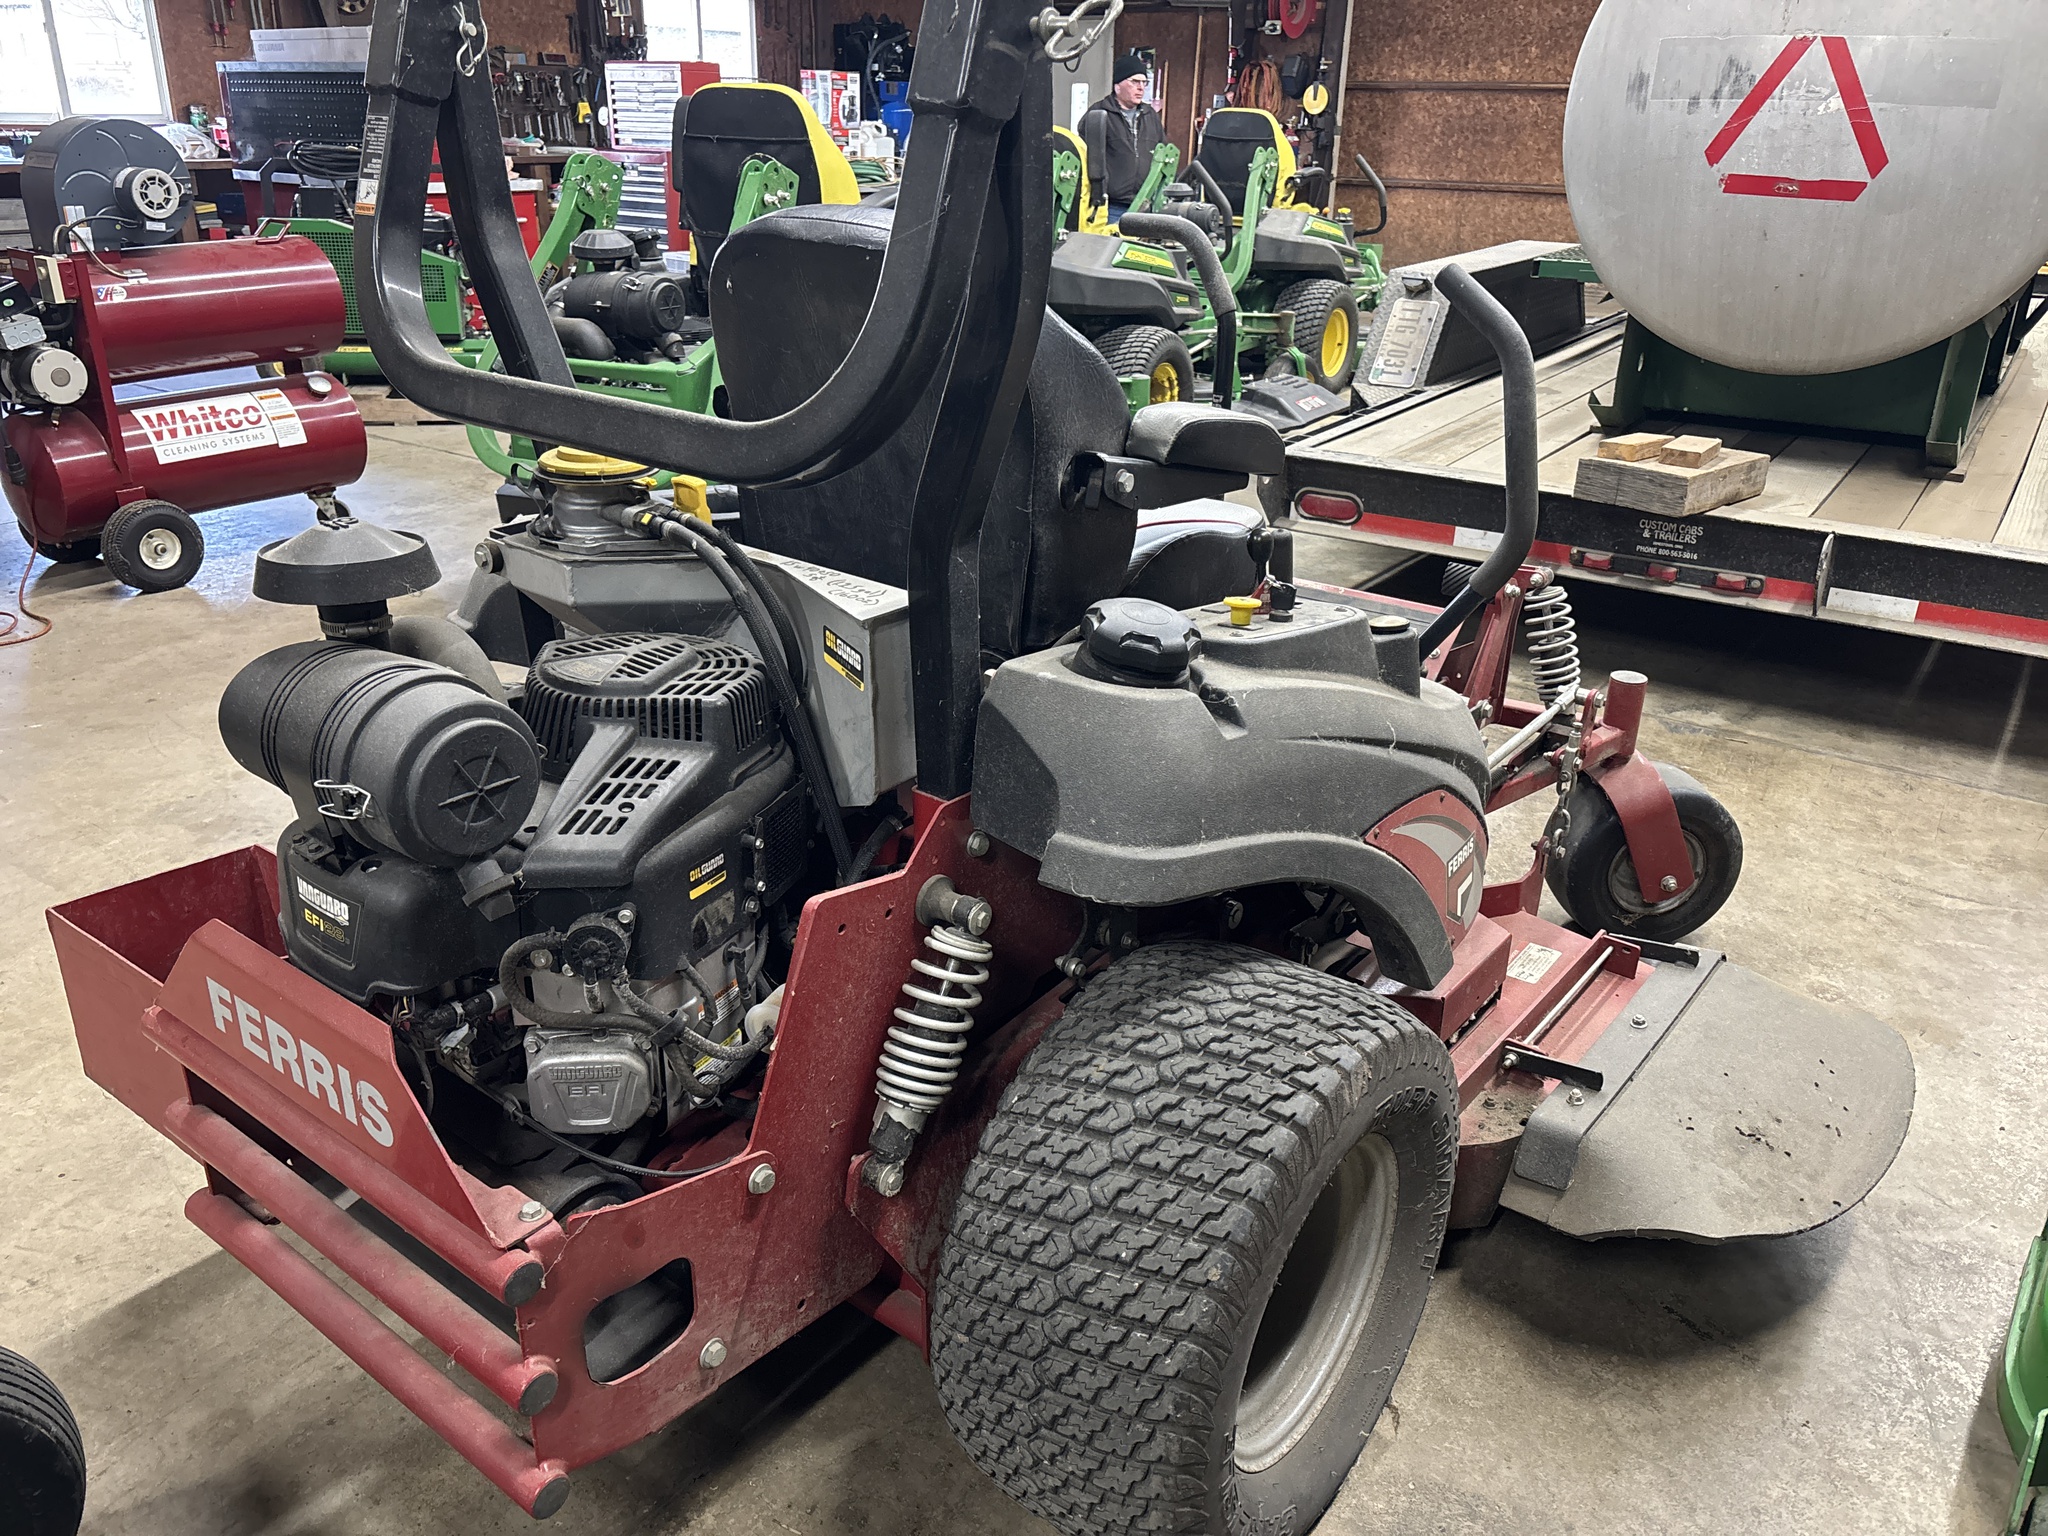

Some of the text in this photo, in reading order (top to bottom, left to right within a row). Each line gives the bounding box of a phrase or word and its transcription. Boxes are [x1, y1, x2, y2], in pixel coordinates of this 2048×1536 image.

[1383, 307, 1424, 377] TTG 7031
[142, 405, 262, 442] Whitco
[163, 432, 266, 457] CLEANING SYSTEMS
[1639, 519, 1704, 536] CUSTOM CABS
[1642, 528, 1698, 544] & TRAILERS
[1636, 545, 1657, 554] PHONE
[1448, 837, 1474, 878] FERRIS
[297, 876, 350, 921] VANGUARD
[206, 976, 395, 1148] FERRIS
[549, 1065, 622, 1081] VANGUARD
[568, 1084, 607, 1097] EFI
